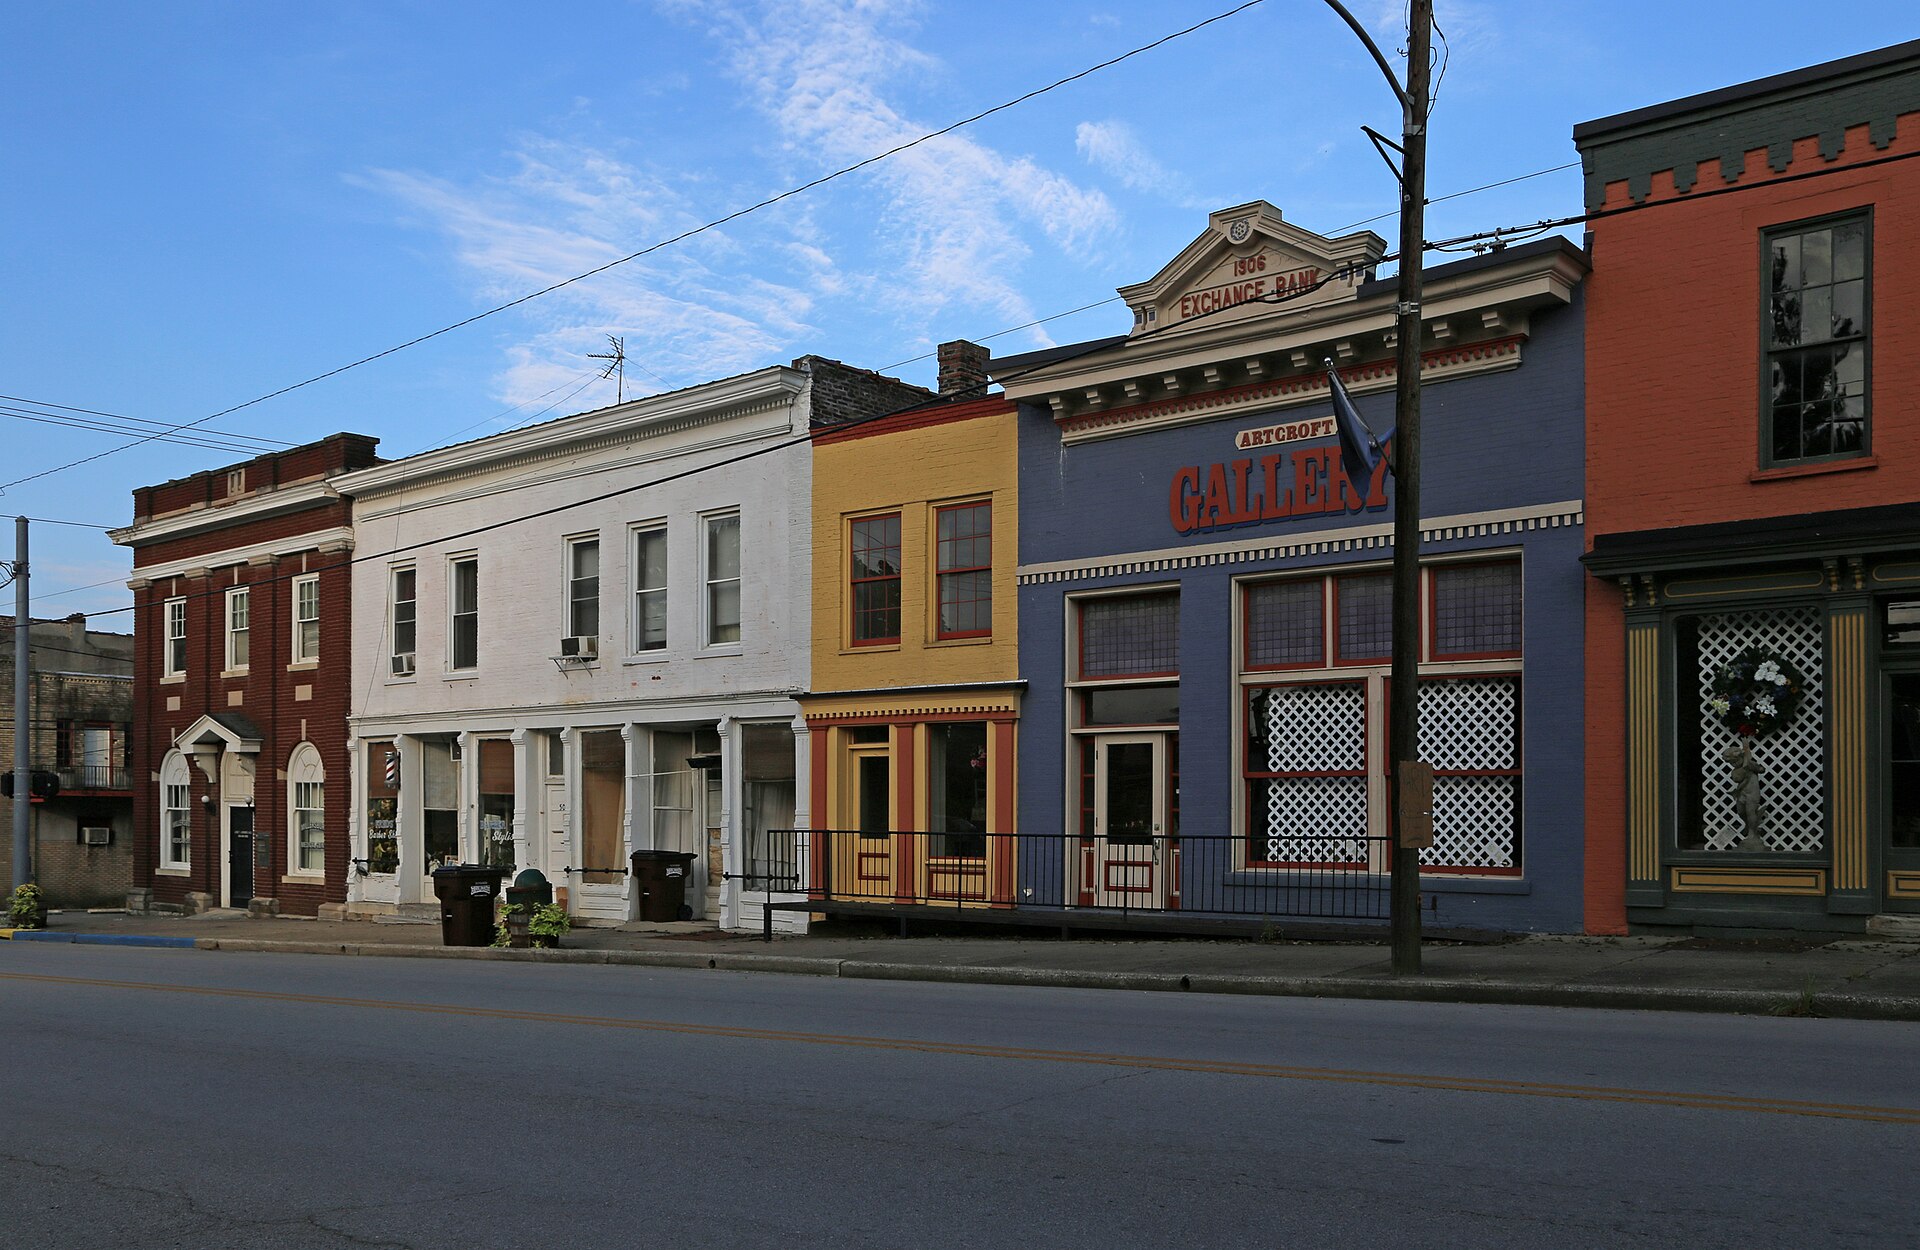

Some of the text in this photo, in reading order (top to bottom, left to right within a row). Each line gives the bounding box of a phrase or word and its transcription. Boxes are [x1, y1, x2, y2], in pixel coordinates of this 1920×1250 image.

[1180, 268, 1322, 319] EXCHANGE BANK
[1239, 418, 1334, 448] ARTCROFT
